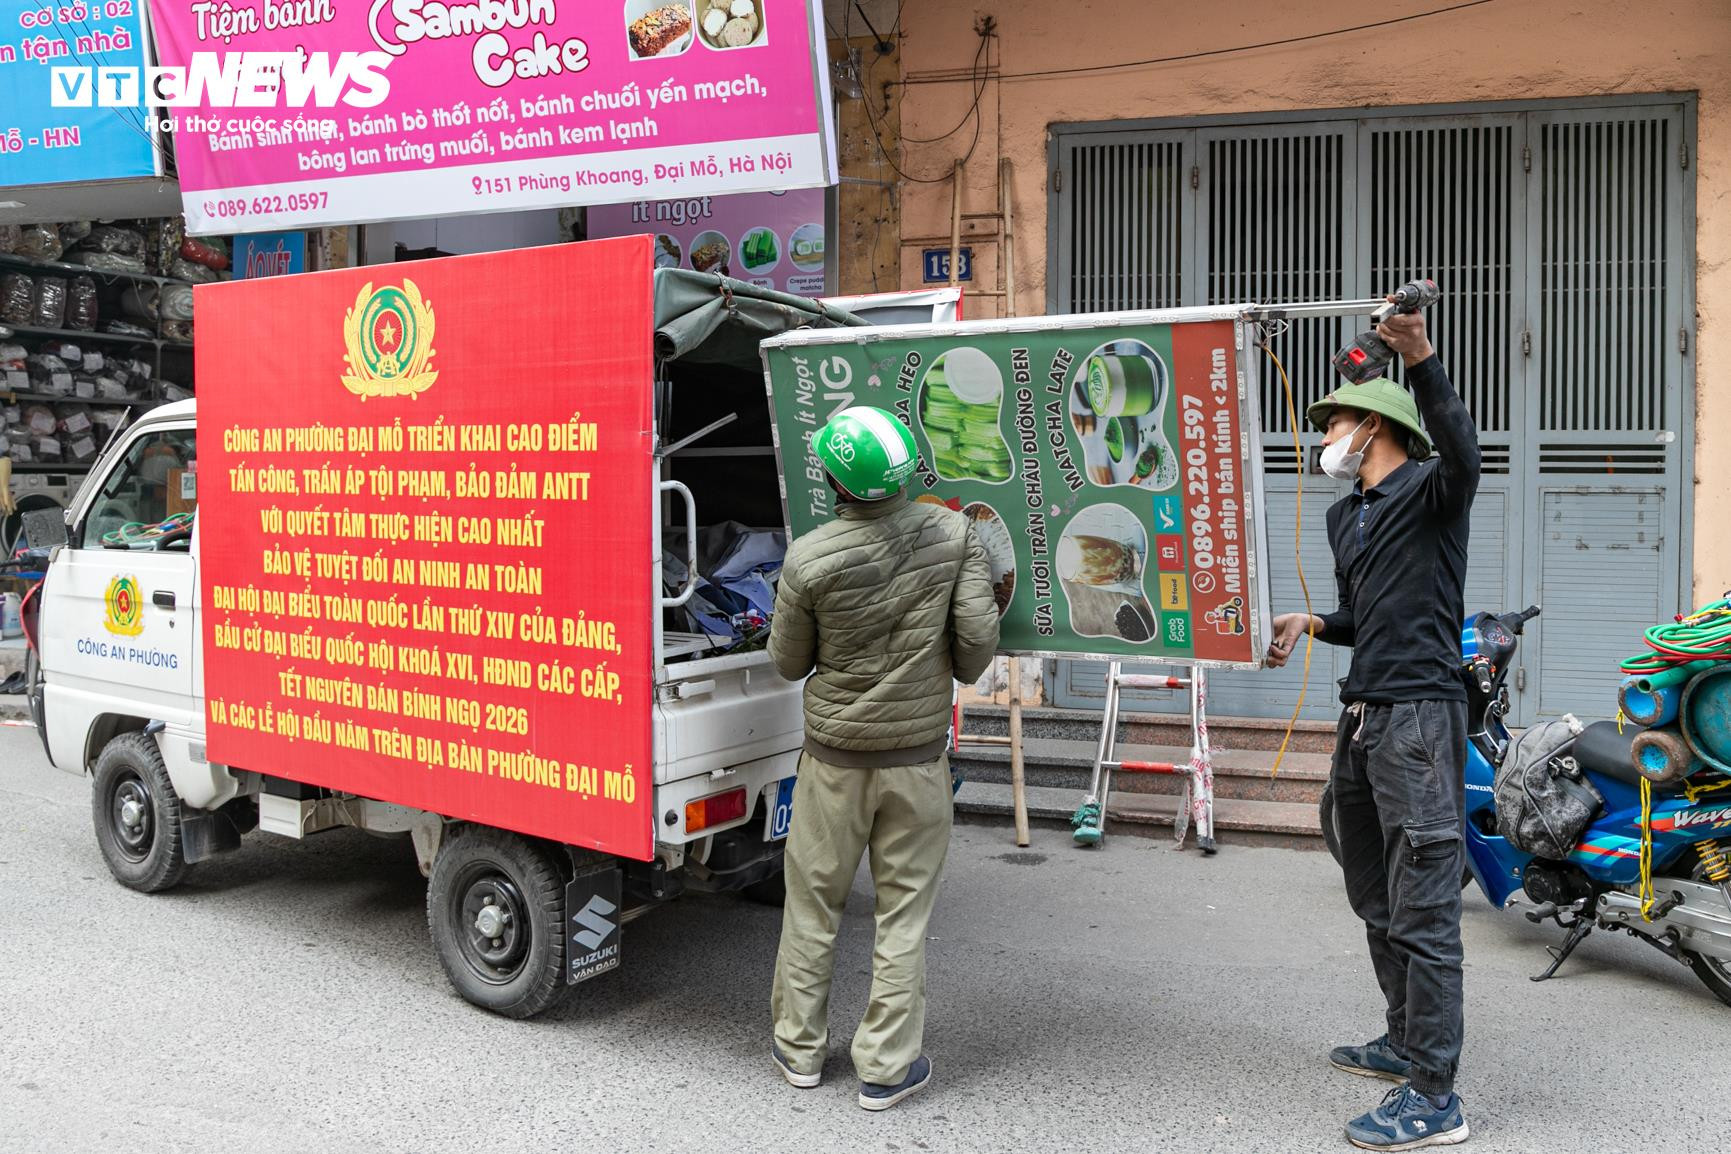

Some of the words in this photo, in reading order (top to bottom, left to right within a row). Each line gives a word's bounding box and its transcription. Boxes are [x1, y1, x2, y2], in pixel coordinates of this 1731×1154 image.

[106, 0, 132, 18] 02
[191, 1, 260, 44] Tiệm
[22, 36, 69, 65] tận
[77, 26, 132, 54] nhà
[472, 31, 590, 88] Cake
[208, 130, 253, 152] Bánh
[348, 114, 397, 137] bánh
[402, 109, 428, 131] bò
[432, 101, 471, 127] thốt
[476, 97, 516, 123] nốt,
[520, 94, 575, 118] bánh
[581, 82, 642, 111] chuối
[646, 77, 687, 109] yến
[694, 74, 767, 103] mạch,
[43, 125, 81, 148] HN
[298, 151, 347, 174] bông
[351, 148, 380, 165] lan
[385, 140, 435, 164] trứng
[440, 129, 495, 156] muối,
[500, 127, 553, 151] bánh
[559, 125, 604, 145] kem
[610, 117, 658, 144] lạnh
[485, 178, 512, 194] 151
[519, 173, 570, 192] Phùng
[576, 167, 649, 187] Khoang,
[654, 162, 684, 183] Đại
[690, 155, 724, 178] Mỗ,
[729, 155, 755, 174] Hà
[761, 152, 792, 174] Nội
[217, 191, 329, 218] 089.622.0597
[655, 196, 713, 226] ngọt
[791, 356, 816, 406] Ngọt
[896, 350, 922, 392] HEO
[1011, 347, 1031, 384] ĐEN
[1046, 347, 1074, 395] LATE
[1210, 348, 1228, 392] 2km
[894, 397, 912, 428] DA
[1015, 388, 1039, 454] ĐƯỜNG
[1212, 409, 1232, 454] kính
[224, 425, 259, 452] CÔNG
[263, 428, 282, 452] AN
[286, 422, 344, 452] PHƯỜNG
[348, 427, 373, 457] ĐẠI
[378, 417, 403, 452] MỖ
[408, 415, 455, 451] TRIỂN
[460, 425, 500, 451] KHAI
[507, 424, 542, 451] CAO
[548, 412, 597, 451] ĐIỂM
[1046, 400, 1086, 492] MATCHA
[229, 461, 255, 492] TẤN
[258, 465, 300, 496] CÔNG,
[303, 461, 341, 494] TRẤN
[345, 465, 365, 494] ÁP
[369, 465, 392, 501] TỘI
[398, 471, 451, 502] PHẠM,
[456, 462, 490, 498] BẢO
[495, 462, 537, 499] ĐẢM
[543, 472, 591, 500] ANTT
[1020, 458, 1044, 509] CHÂU
[1182, 394, 1214, 569] 0896.220.597
[1214, 458, 1235, 494] bán
[811, 489, 829, 517] Trà
[1218, 498, 1239, 540] ship
[261, 505, 282, 533] VỚI
[286, 504, 329, 537] QUYẾT
[333, 507, 365, 537] TÂM
[369, 512, 409, 545] THỰC
[414, 510, 452, 548] HIỆN
[458, 517, 491, 544] CAO
[497, 510, 544, 547] NHẤT
[1025, 512, 1049, 556] TRÂN
[264, 543, 291, 574] BẢO
[294, 547, 311, 581] VỆ
[315, 550, 358, 585] TUYỆT
[362, 549, 388, 582] ĐỐI
[393, 559, 415, 585] AN
[420, 560, 460, 589] NINH
[466, 563, 489, 591] AN
[494, 561, 542, 595] TOÀN
[1031, 560, 1052, 599] TƯƠI
[1217, 544, 1241, 594] Miễn
[214, 586, 235, 614] ĐẠI
[238, 584, 259, 616] HỘI
[263, 590, 284, 619] ĐẠI
[289, 585, 320, 619] BIỂU
[324, 593, 362, 623] TOÀN
[367, 593, 408, 628] QUỐC
[413, 596, 444, 632] LẦN
[449, 604, 482, 636] THỨ
[486, 611, 514, 639] XIV
[519, 606, 557, 644] CỦA
[562, 610, 622, 655] ĐẢNG,
[1033, 603, 1053, 636] SỮA
[1168, 617, 1177, 642] Grab
[1176, 617, 1185, 642] Food
[77, 637, 107, 657] CÔNG
[111, 645, 125, 660] AN
[129, 647, 177, 669] PHƯỜNG
[215, 618, 240, 649] BẦU
[243, 621, 261, 651] CỬ
[264, 630, 286, 660] ĐẠI
[290, 626, 321, 660] BIỂU
[326, 632, 364, 666] QUỐC
[369, 639, 394, 675] HỘI
[399, 645, 441, 677] KHOÁ
[446, 652, 478, 685] XVI,
[483, 657, 531, 688] HĐND
[537, 659, 575, 695] CÁC
[581, 661, 622, 705] CẤP,
[279, 666, 301, 698] TẾT
[306, 677, 362, 708] NGUYÊN
[367, 683, 398, 714] ĐÁN
[403, 687, 441, 721] BÍNH
[446, 697, 481, 733] NGỌ
[485, 704, 528, 735] 2026
[211, 697, 227, 724] VÀ
[230, 701, 255, 730] CÁC
[259, 701, 274, 733] LỄ
[277, 709, 299, 742] HỘI
[303, 710, 331, 744] ĐẦU
[335, 719, 369, 751] NĂM
[372, 727, 412, 760] TRÊN
[416, 736, 444, 770] ĐỊA
[448, 739, 482, 773] BÀN
[488, 749, 560, 789] PHƯỜNG
[566, 763, 597, 800] ĐẠI
[604, 764, 635, 804] MỖ
[1674, 808, 1731, 828] Wave
[572, 944, 617, 969] SUZUKI
